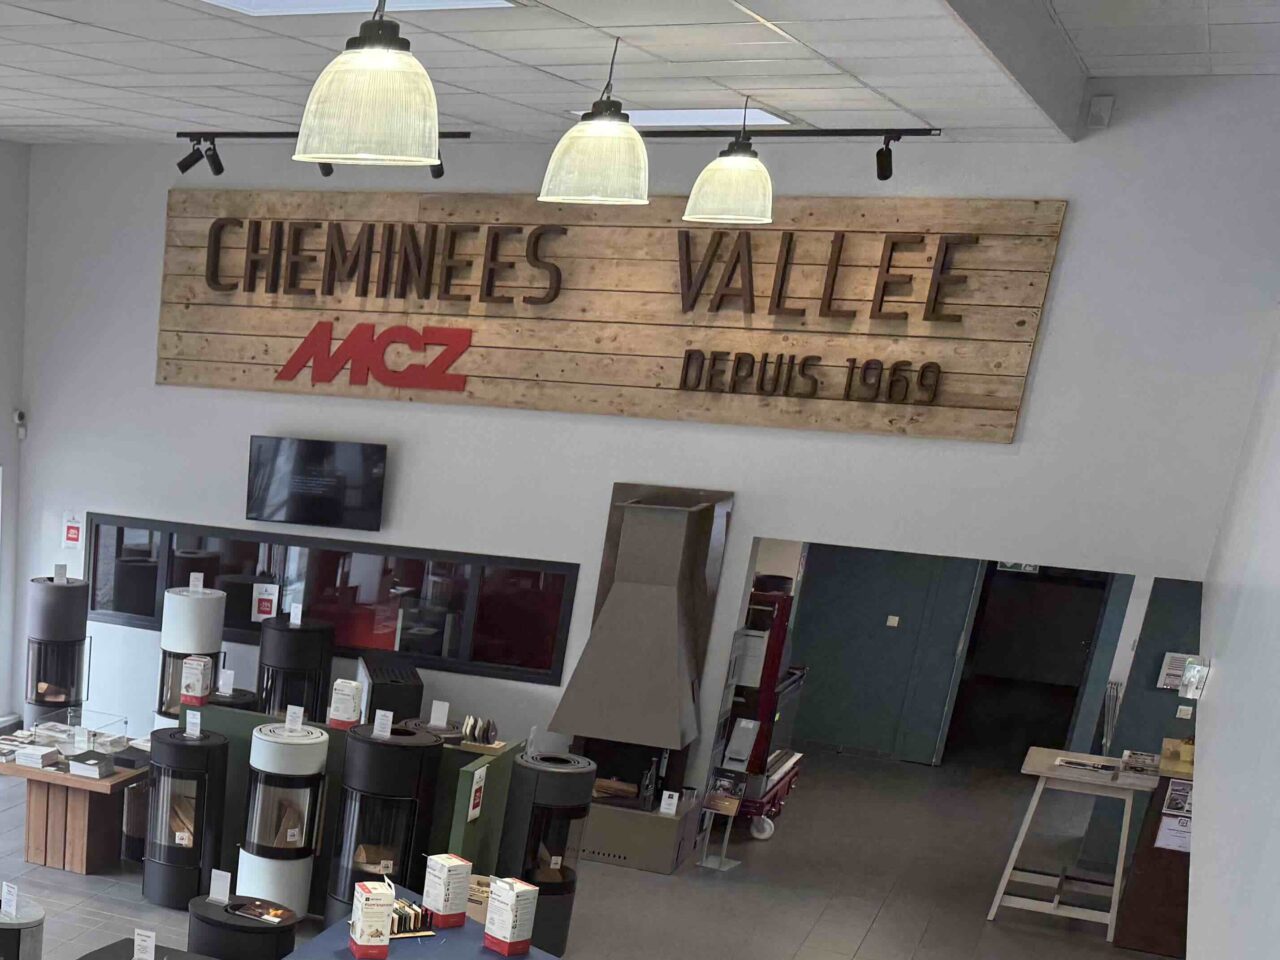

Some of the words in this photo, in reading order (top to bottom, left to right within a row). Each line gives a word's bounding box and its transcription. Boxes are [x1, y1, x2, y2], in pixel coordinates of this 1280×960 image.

[205, 217, 568, 305] CHEMINEES
[677, 230, 979, 323] VALLEE
[274, 320, 472, 391] MCZ
[679, 349, 822, 398] DEPUIS
[843, 357, 942, 406] 1969
